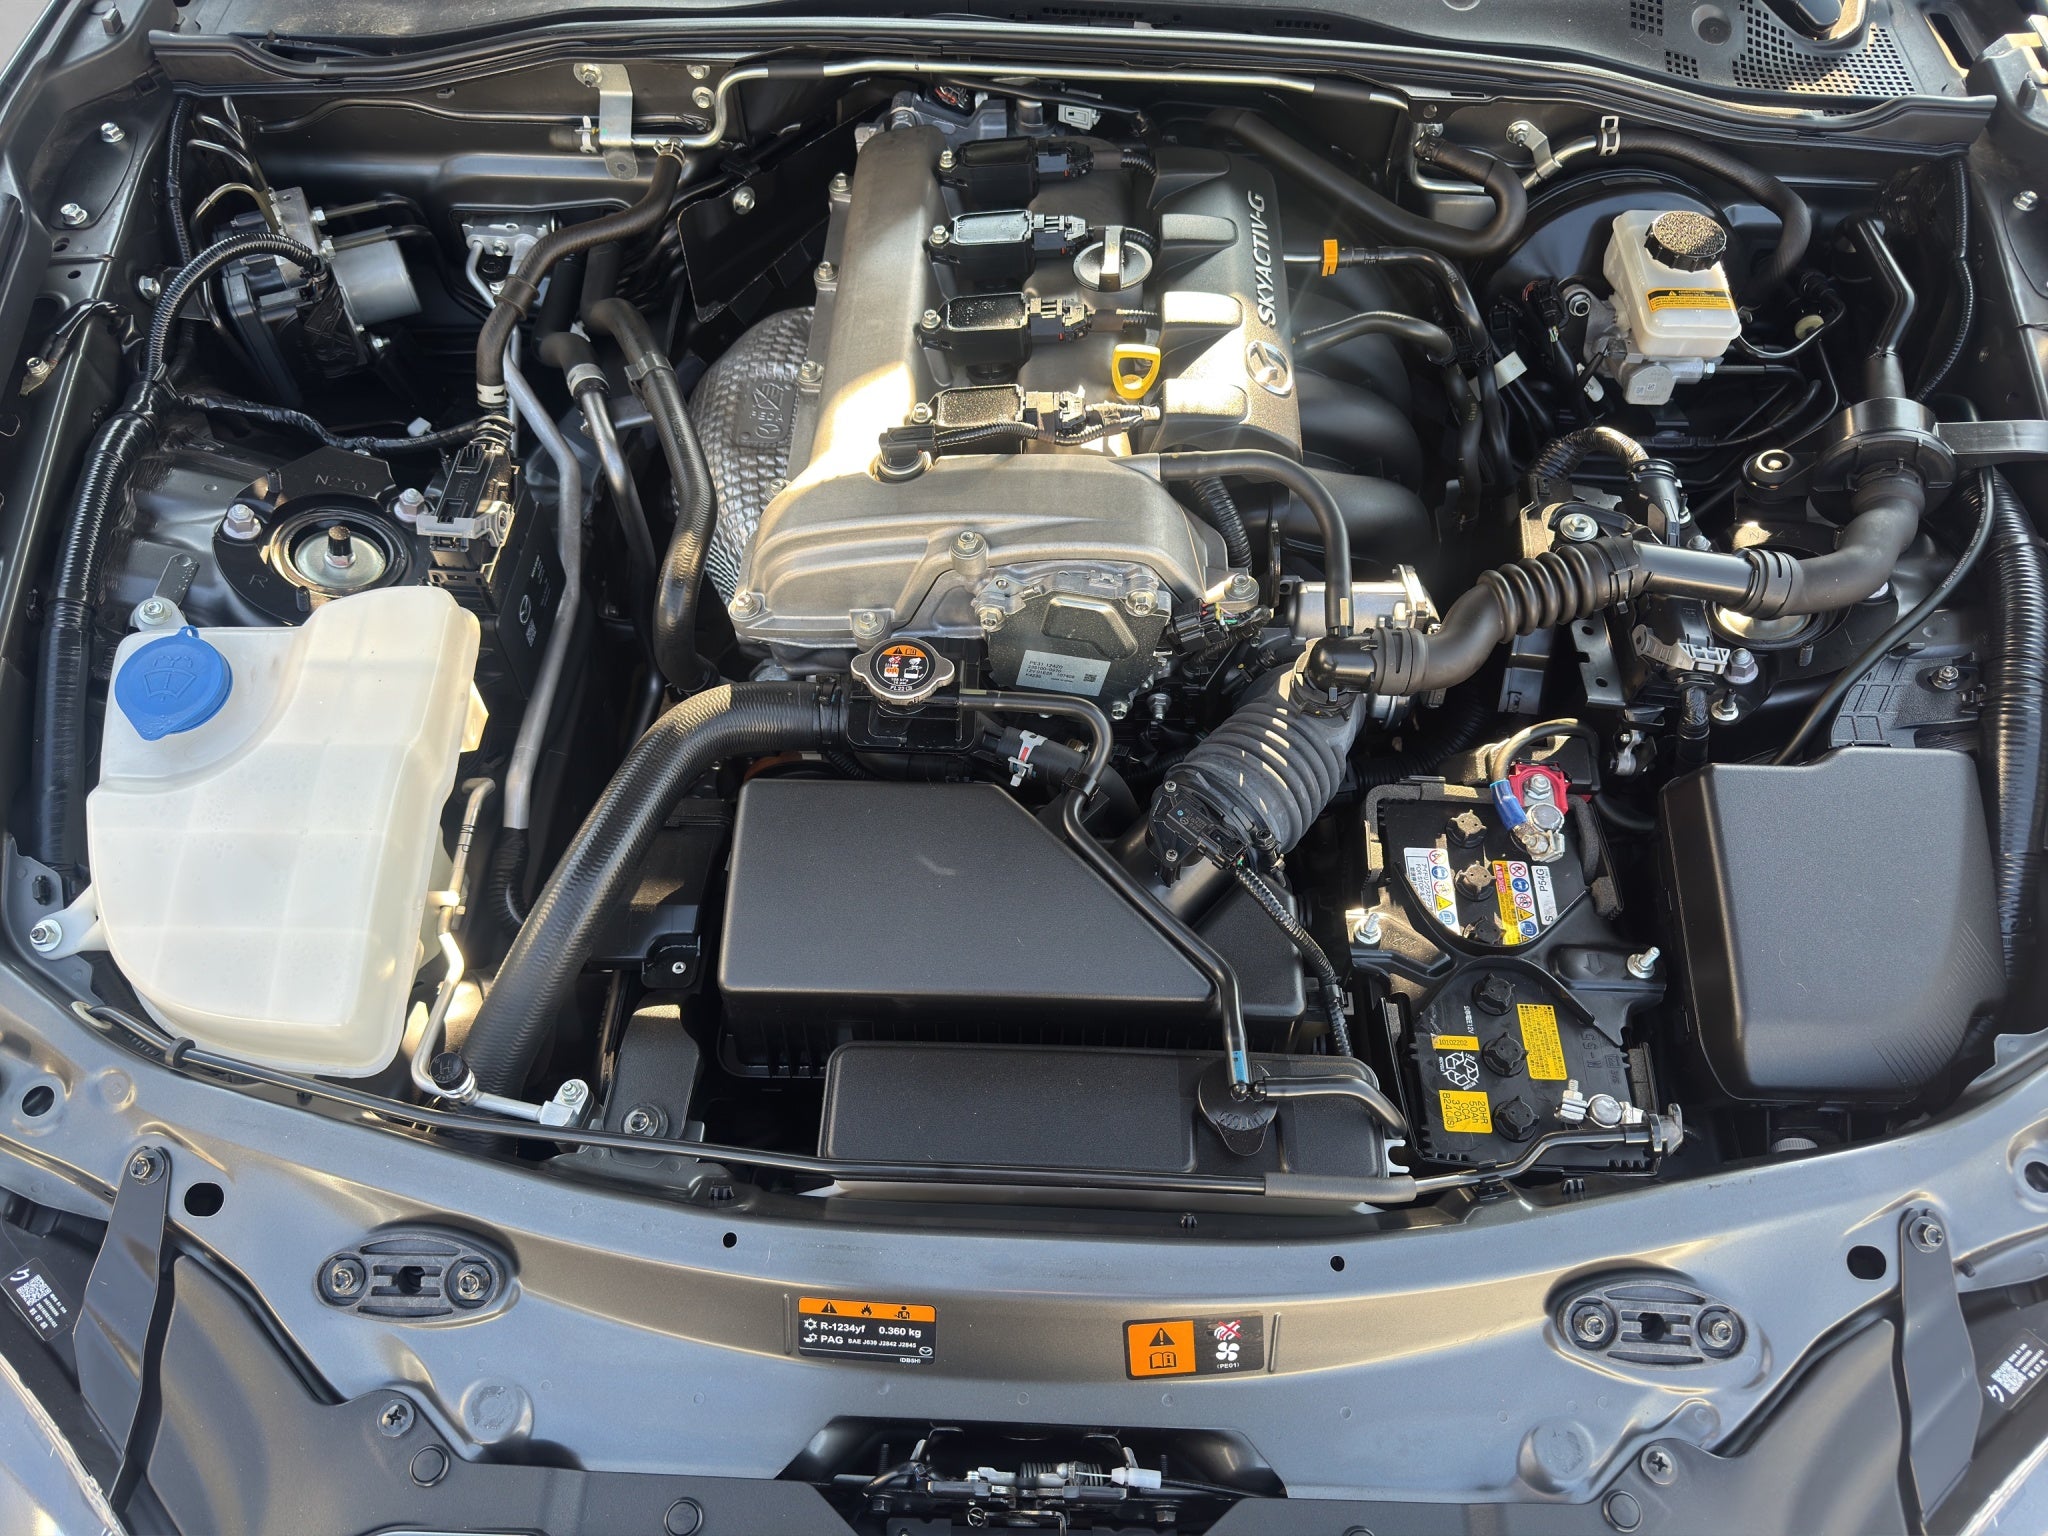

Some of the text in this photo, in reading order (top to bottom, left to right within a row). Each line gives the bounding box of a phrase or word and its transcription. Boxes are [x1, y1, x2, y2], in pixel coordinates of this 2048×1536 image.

[1247, 190, 1277, 328] SKYACTIV-G
[1534, 868, 1549, 892] P54G
[1452, 1099, 1462, 1123] 370A
[1461, 1102, 1471, 1121] CCA
[1469, 1100, 1479, 1124] 50Ah
[1477, 1100, 1489, 1124] 20HR
[820, 1321, 922, 1338] R-1234yf 0.360 kg
[820, 1334, 844, 1345] PAG
